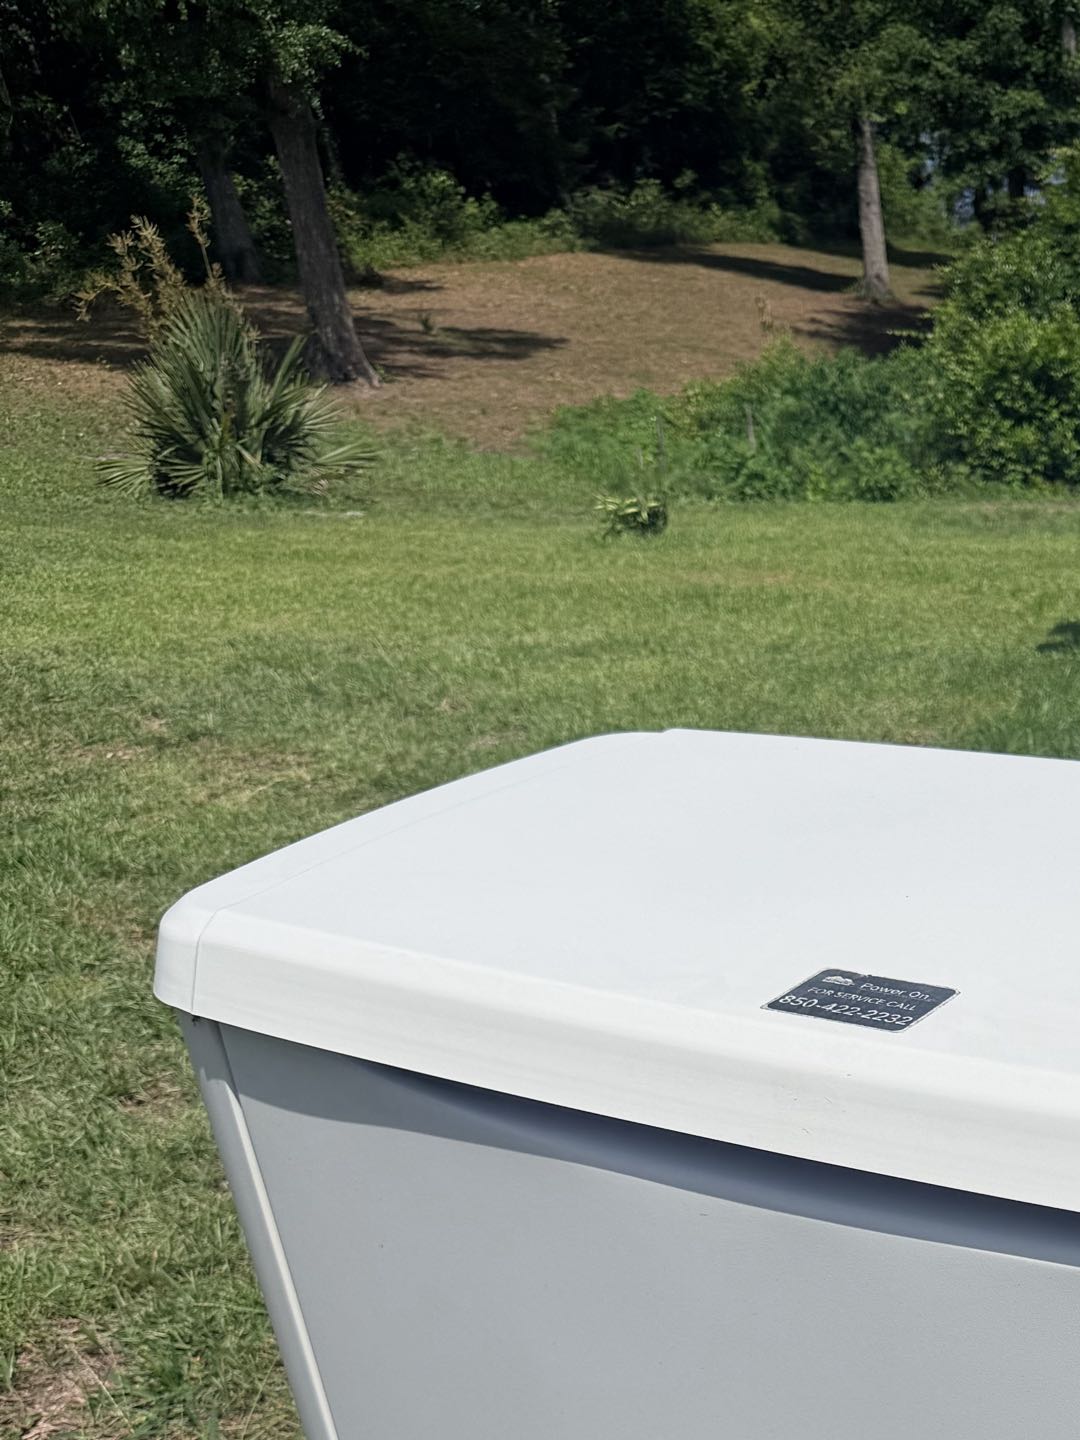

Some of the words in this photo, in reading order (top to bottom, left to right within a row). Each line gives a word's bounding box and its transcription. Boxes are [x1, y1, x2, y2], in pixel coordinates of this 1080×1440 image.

[807, 986, 834, 996] FOR
[834, 992, 886, 1005] SERVICE
[886, 1001, 917, 1011] CALL
[860, 982, 907, 995] Power
[779, 995, 913, 1026] 850-422-2232
